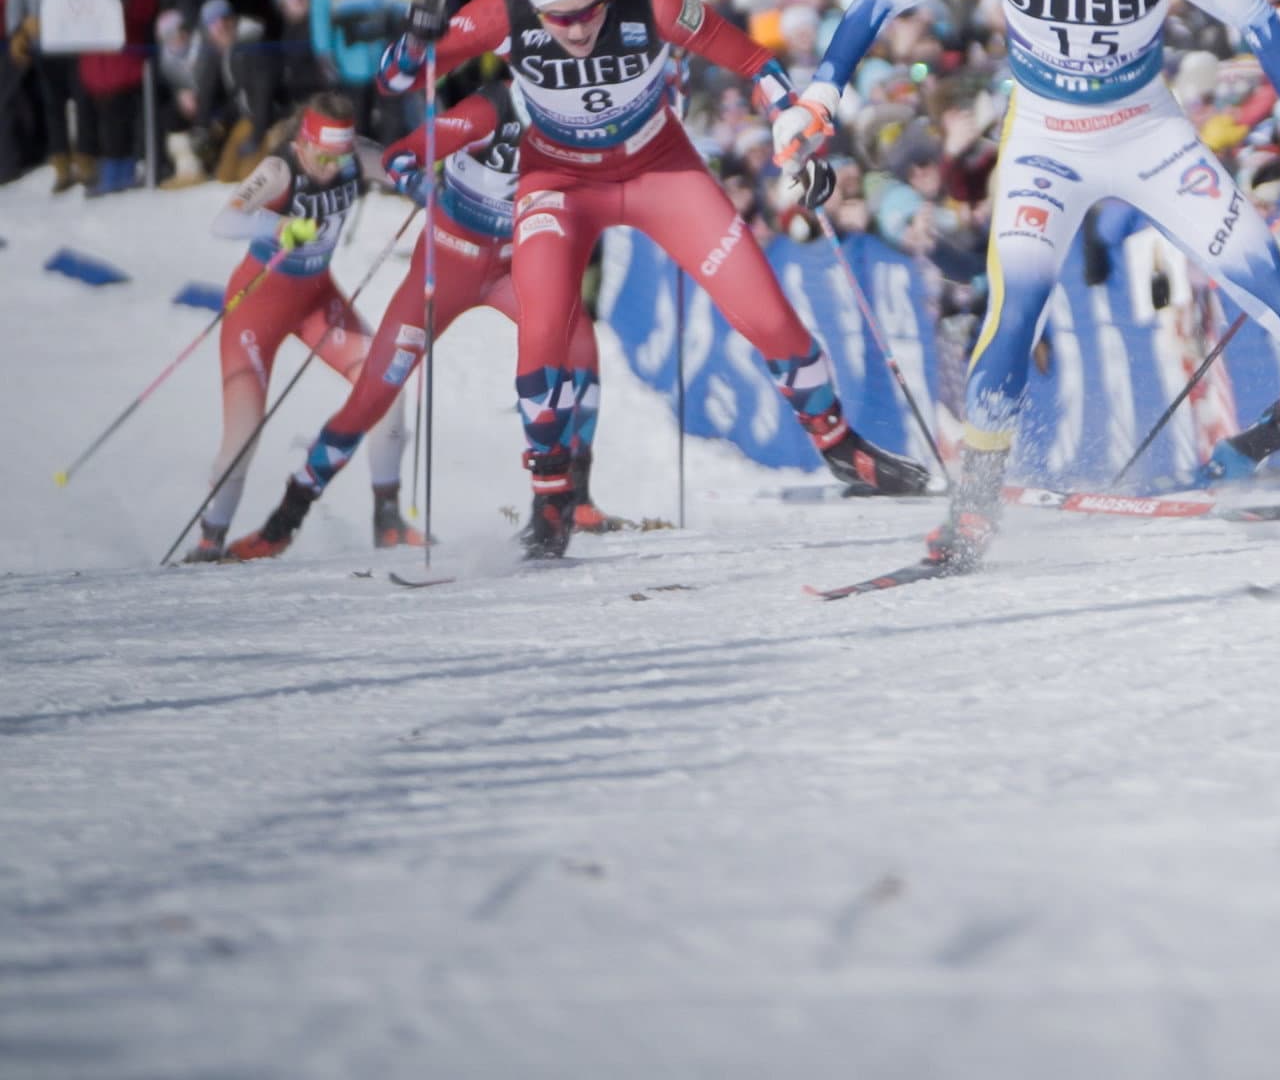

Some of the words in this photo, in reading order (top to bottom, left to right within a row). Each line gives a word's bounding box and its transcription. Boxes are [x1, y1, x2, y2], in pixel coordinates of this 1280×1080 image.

[1049, 25, 1120, 60] 15
[581, 88, 613, 113] 8
[1208, 190, 1244, 256] CRAFT
